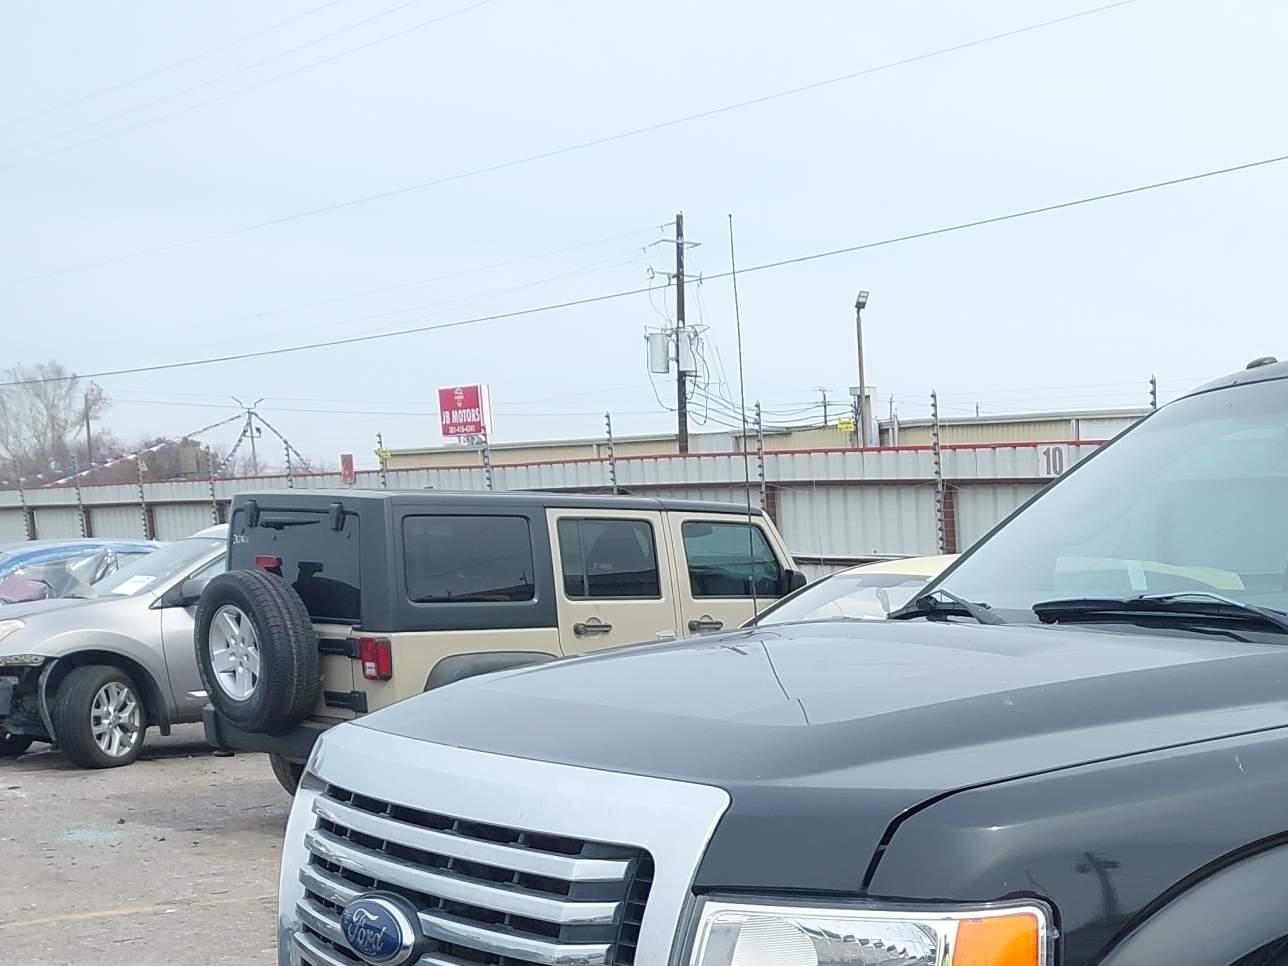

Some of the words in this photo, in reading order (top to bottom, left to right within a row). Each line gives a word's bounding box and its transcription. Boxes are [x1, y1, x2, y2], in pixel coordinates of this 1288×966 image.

[442, 410, 451, 425] JB
[452, 408, 481, 424] MOTORS
[1042, 446, 1064, 476] 10
[347, 907, 387, 952] Ford
